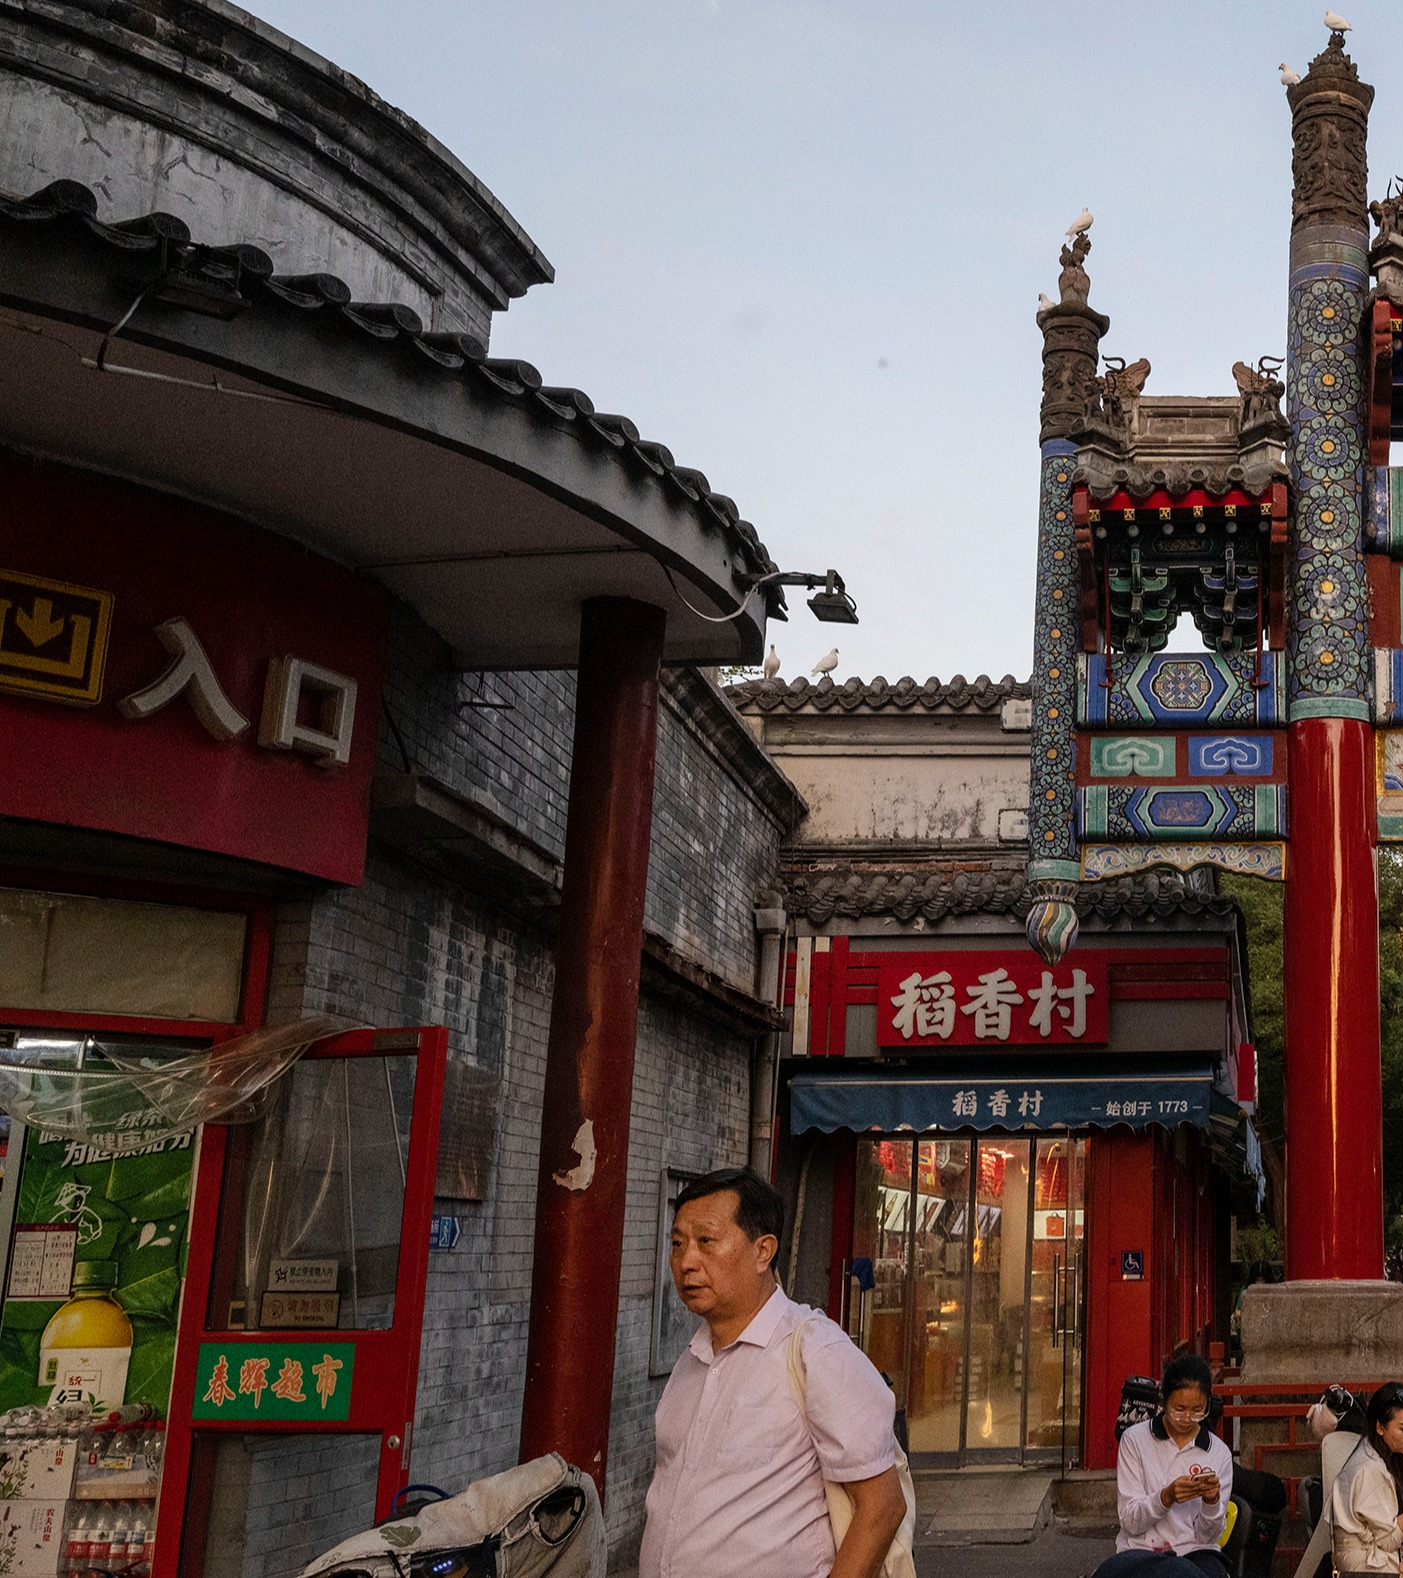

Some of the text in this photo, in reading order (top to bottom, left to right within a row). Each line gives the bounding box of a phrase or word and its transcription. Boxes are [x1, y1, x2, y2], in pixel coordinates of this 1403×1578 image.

[115, 617, 358, 767] 入口
[891, 968, 1095, 1041] 稻香村
[952, 1089, 1044, 1117] 稻香村
[1106, 1100, 1188, 1117] 始创于 1773
